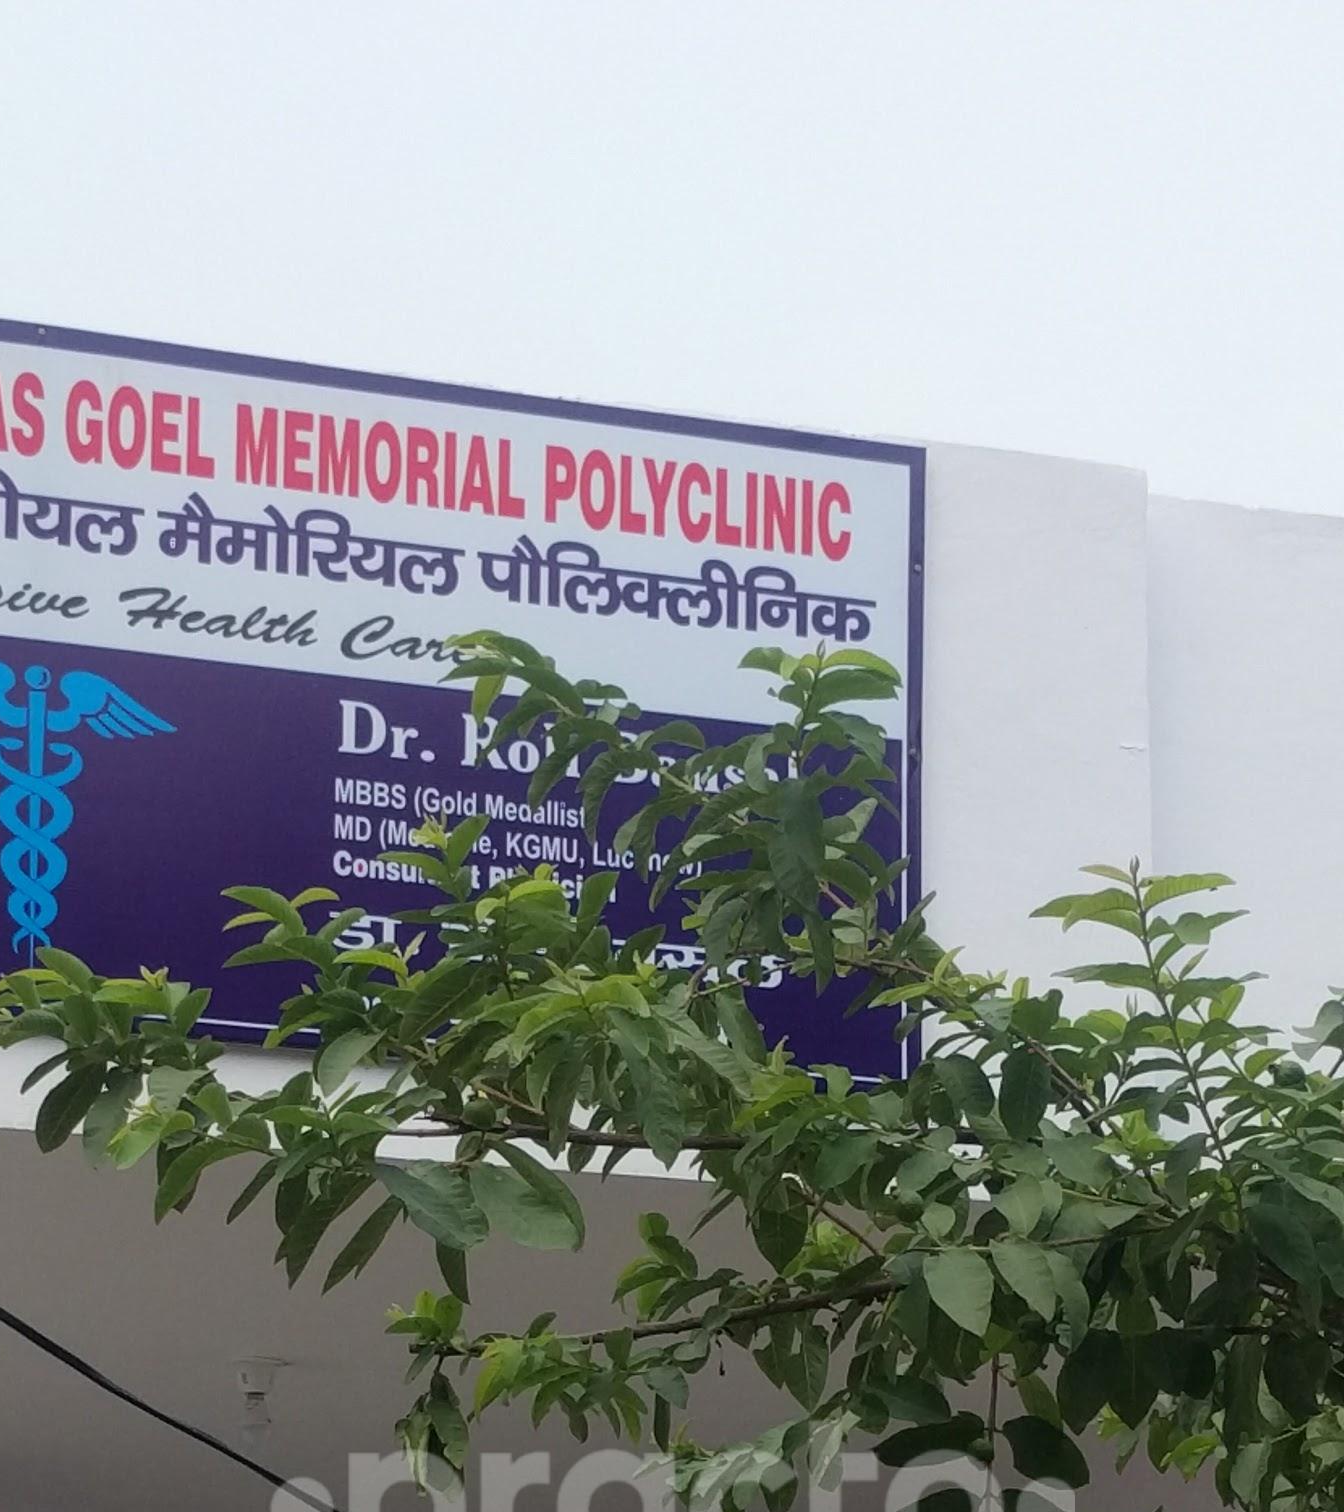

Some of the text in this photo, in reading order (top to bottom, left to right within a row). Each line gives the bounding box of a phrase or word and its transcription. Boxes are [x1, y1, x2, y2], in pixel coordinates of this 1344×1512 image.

[65, 379, 216, 480] GOEL
[235, 402, 525, 520] MEMORIAL
[544, 445, 852, 562] POLYCLINIC
[157, 492, 465, 597] मैमोरियल
[478, 534, 877, 643] पौलिक्लीनिक
[118, 586, 318, 647] Health
[339, 699, 436, 763] Dr.
[334, 777, 406, 810] MBBS
[414, 786, 478, 818] (Gold
[334, 813, 372, 842] MD
[506, 832, 585, 869] KGMU,
